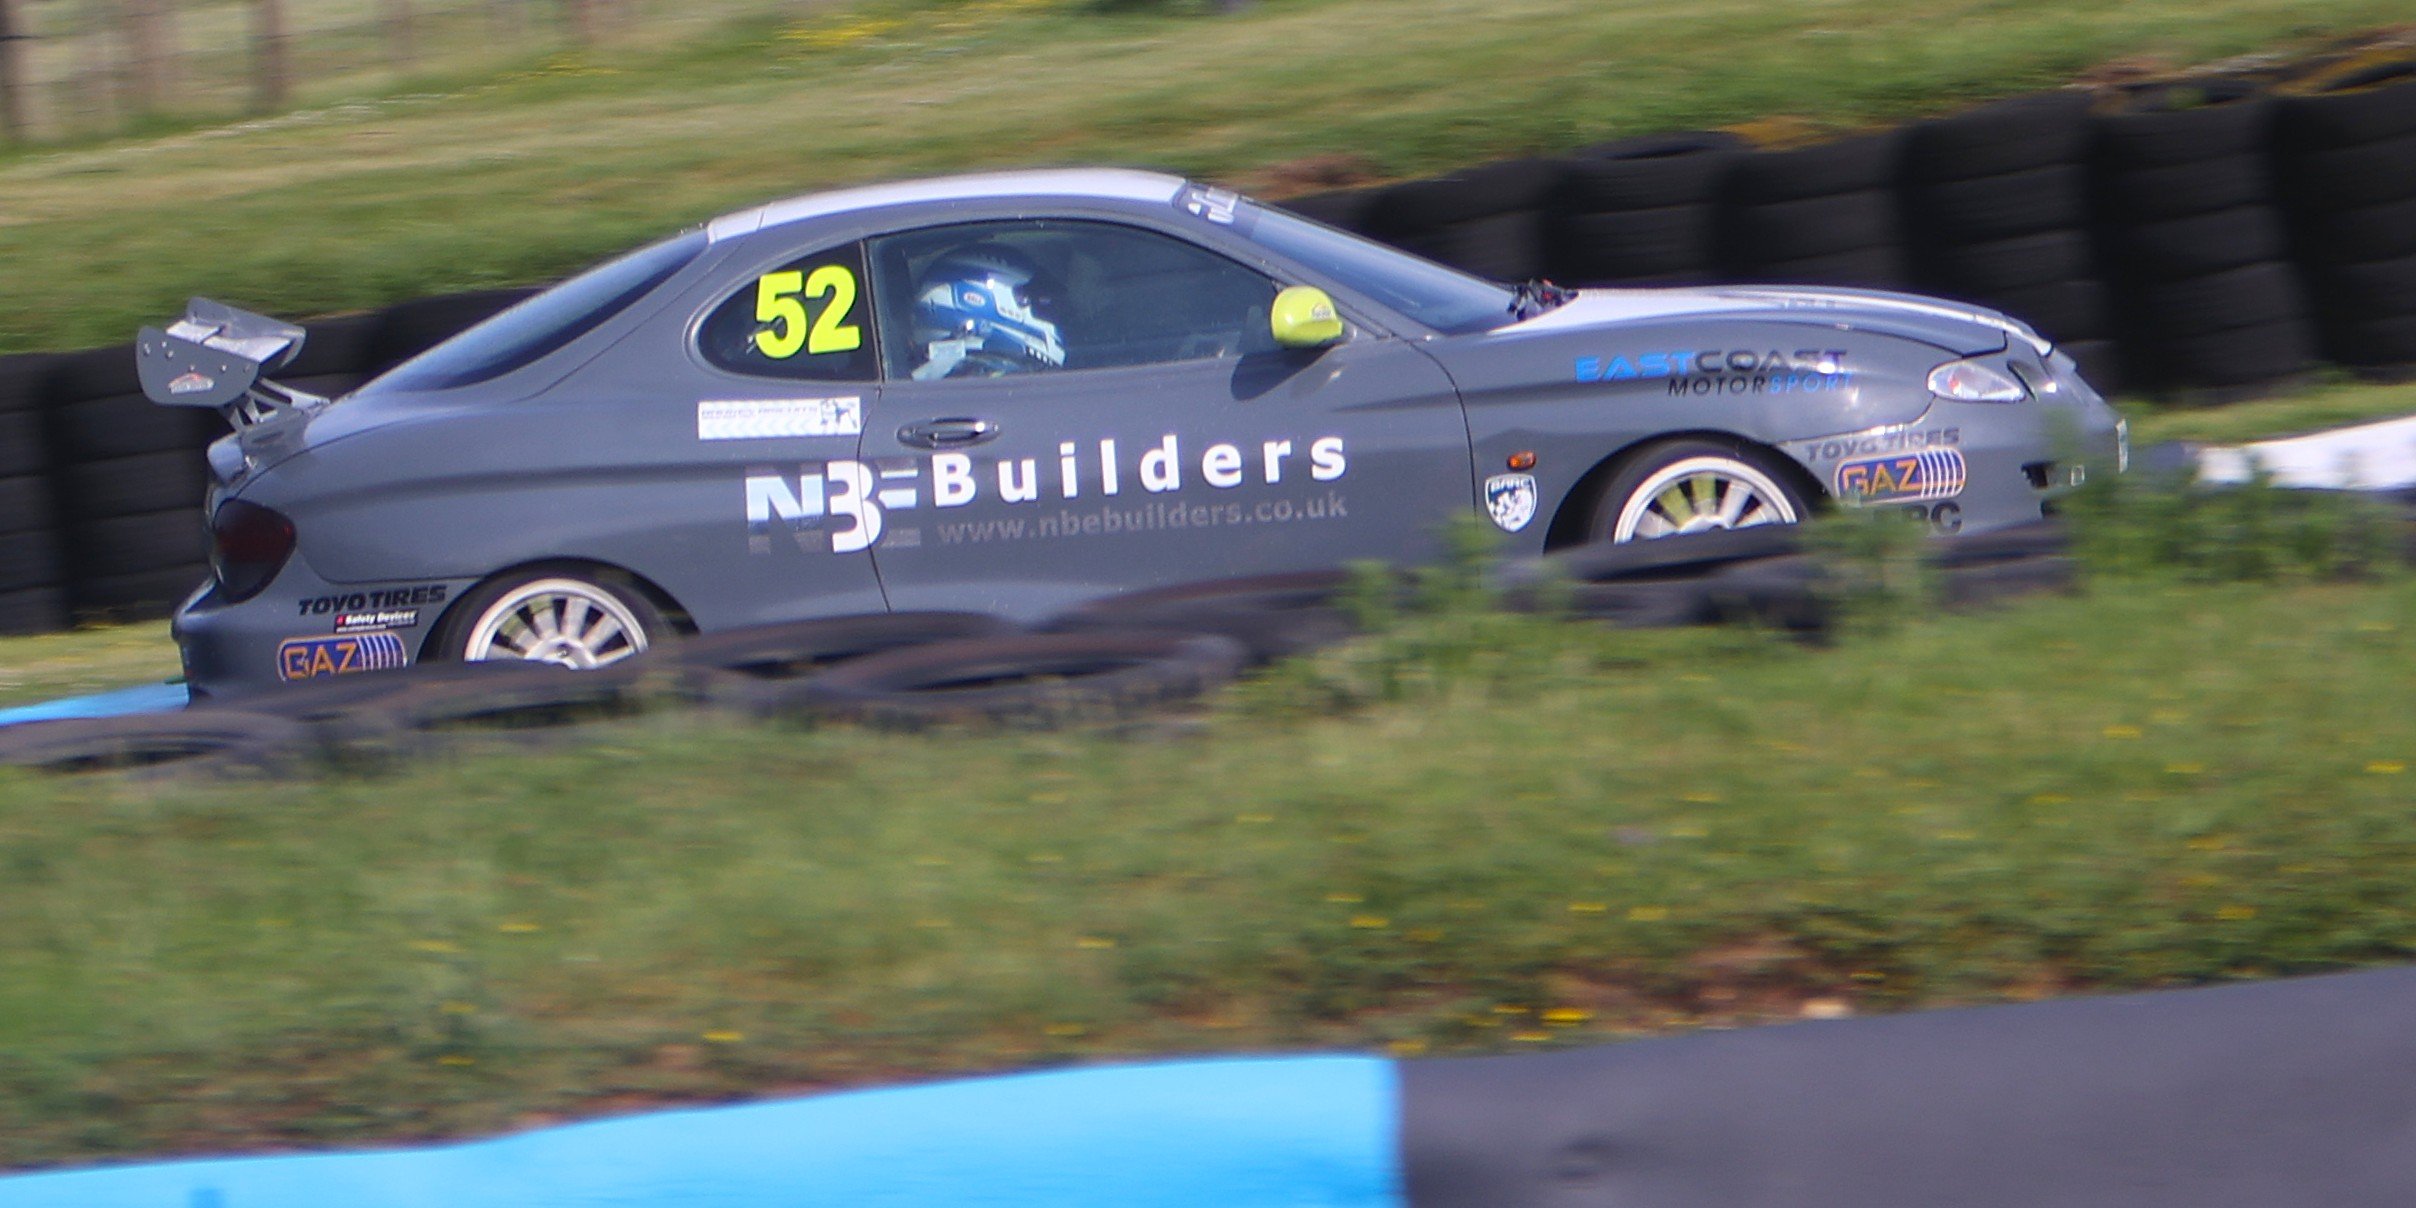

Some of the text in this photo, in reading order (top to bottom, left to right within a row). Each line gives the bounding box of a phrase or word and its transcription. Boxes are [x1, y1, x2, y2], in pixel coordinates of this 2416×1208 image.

[755, 265, 861, 359] 52
[1668, 373, 1850, 397] MOTORSPORT
[932, 434, 1347, 508] Builders
[1842, 458, 1922, 496] GAZ
[938, 491, 1349, 545] www.nbebuilders.co.uk
[300, 585, 447, 615] TOYO TIRES
[345, 614, 376, 626] Safety
[284, 642, 358, 680] GAZ
